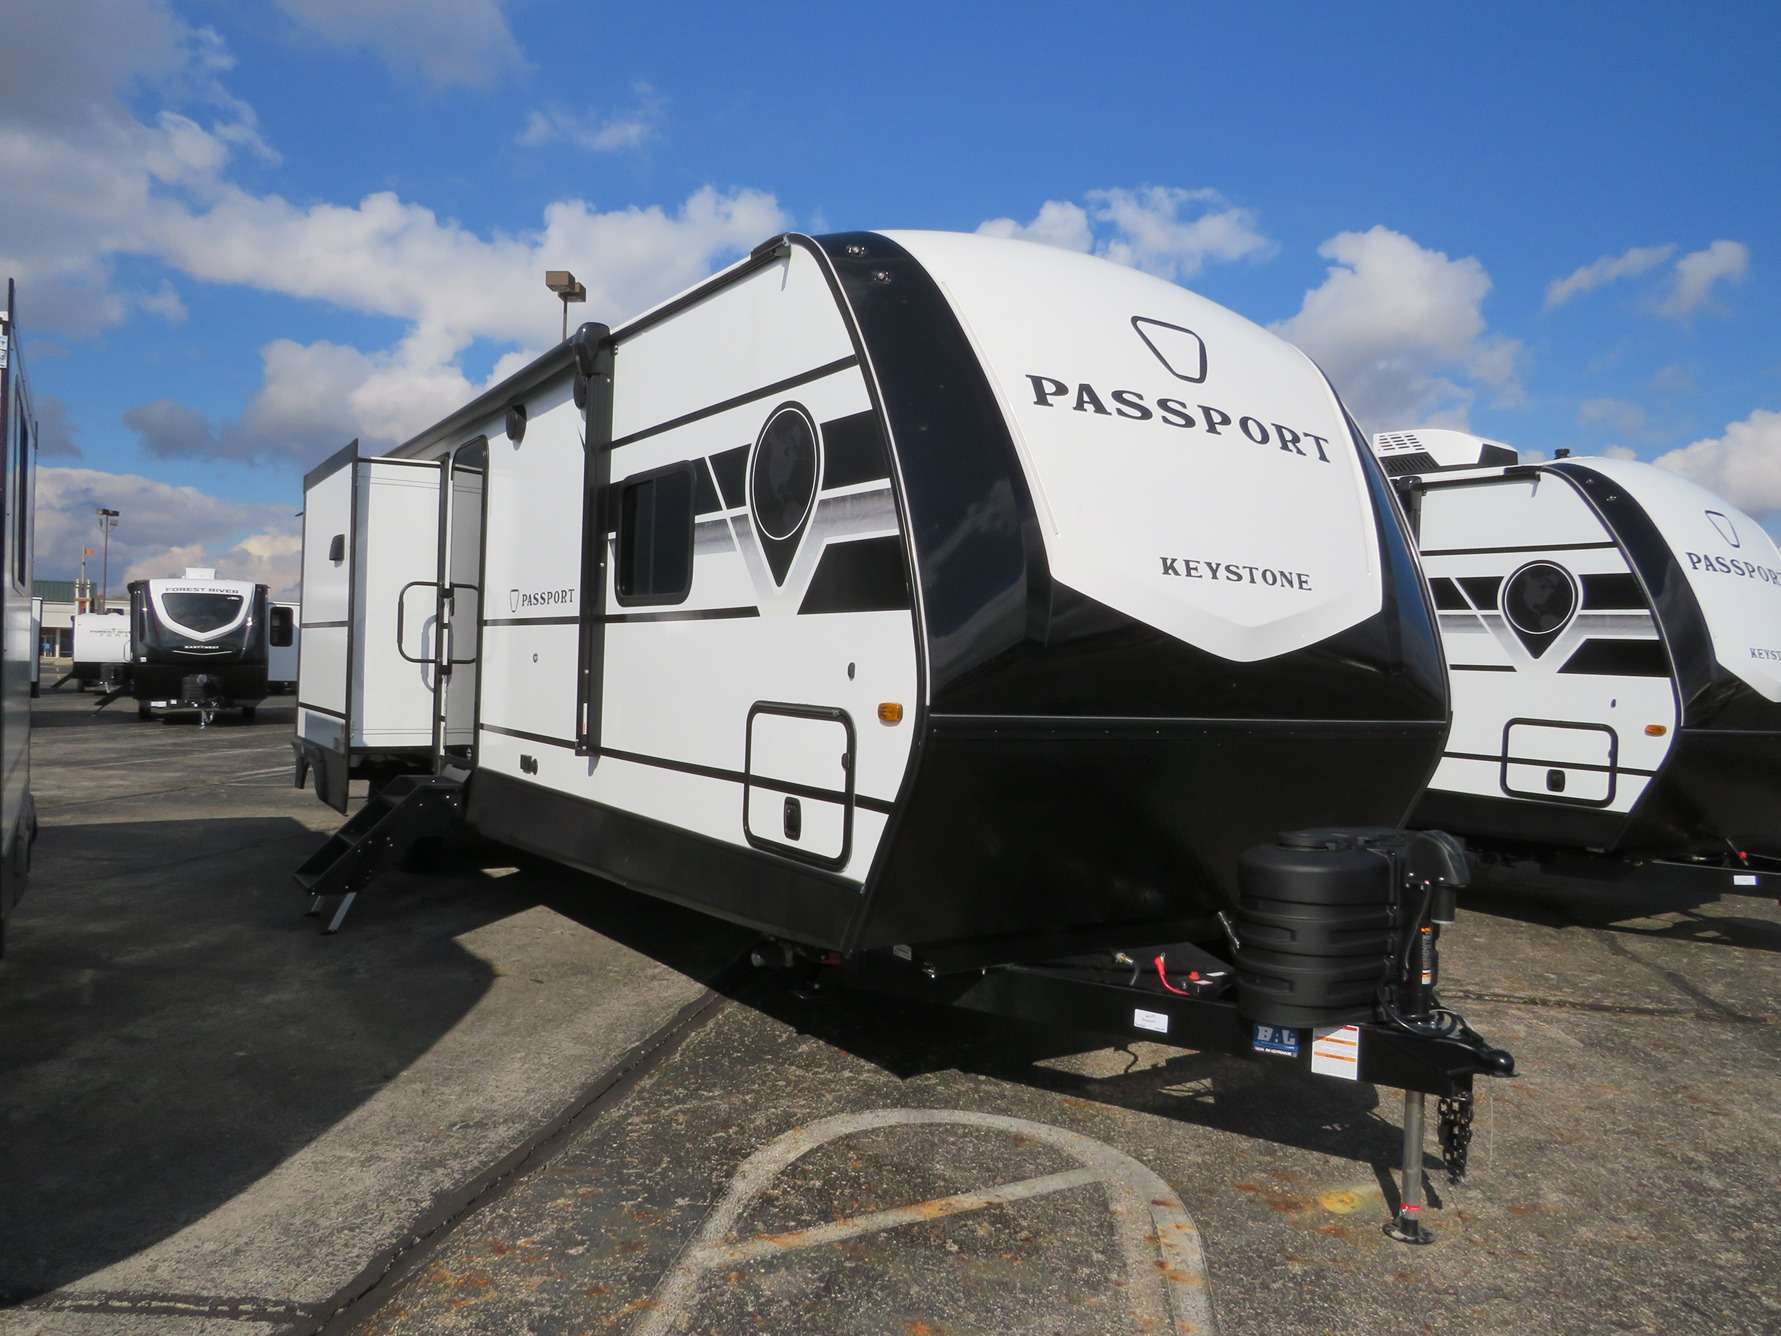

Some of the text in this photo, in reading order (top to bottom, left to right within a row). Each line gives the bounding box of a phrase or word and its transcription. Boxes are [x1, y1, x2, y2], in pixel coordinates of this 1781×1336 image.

[1025, 374, 1331, 463] PASSPORT
[1160, 556, 1313, 591] KEYSTONE
[521, 588, 575, 607] PASSPORT
